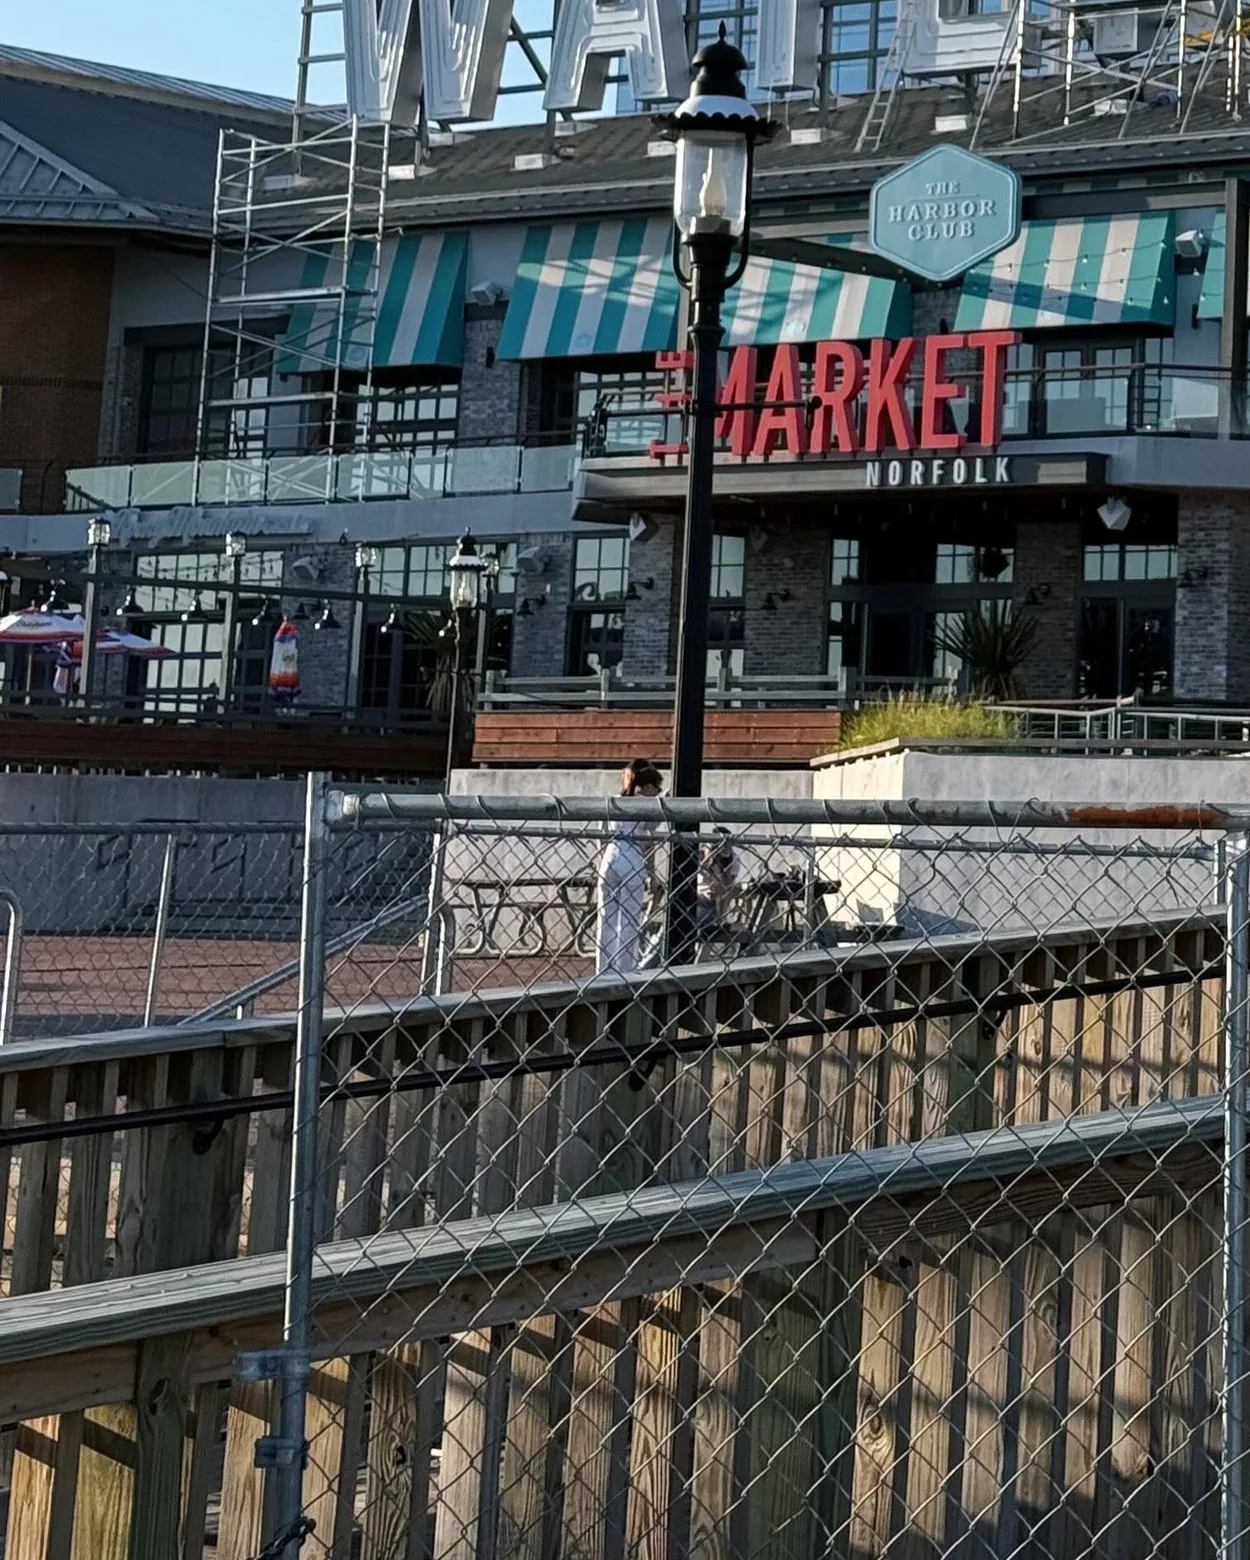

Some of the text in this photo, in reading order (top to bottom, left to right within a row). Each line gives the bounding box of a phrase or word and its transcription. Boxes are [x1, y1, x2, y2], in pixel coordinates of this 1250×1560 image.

[925, 181, 960, 195] THE
[888, 199, 996, 223] HARBOR
[908, 220, 975, 241] CLUB
[865, 456, 1010, 489] NORFOLK
